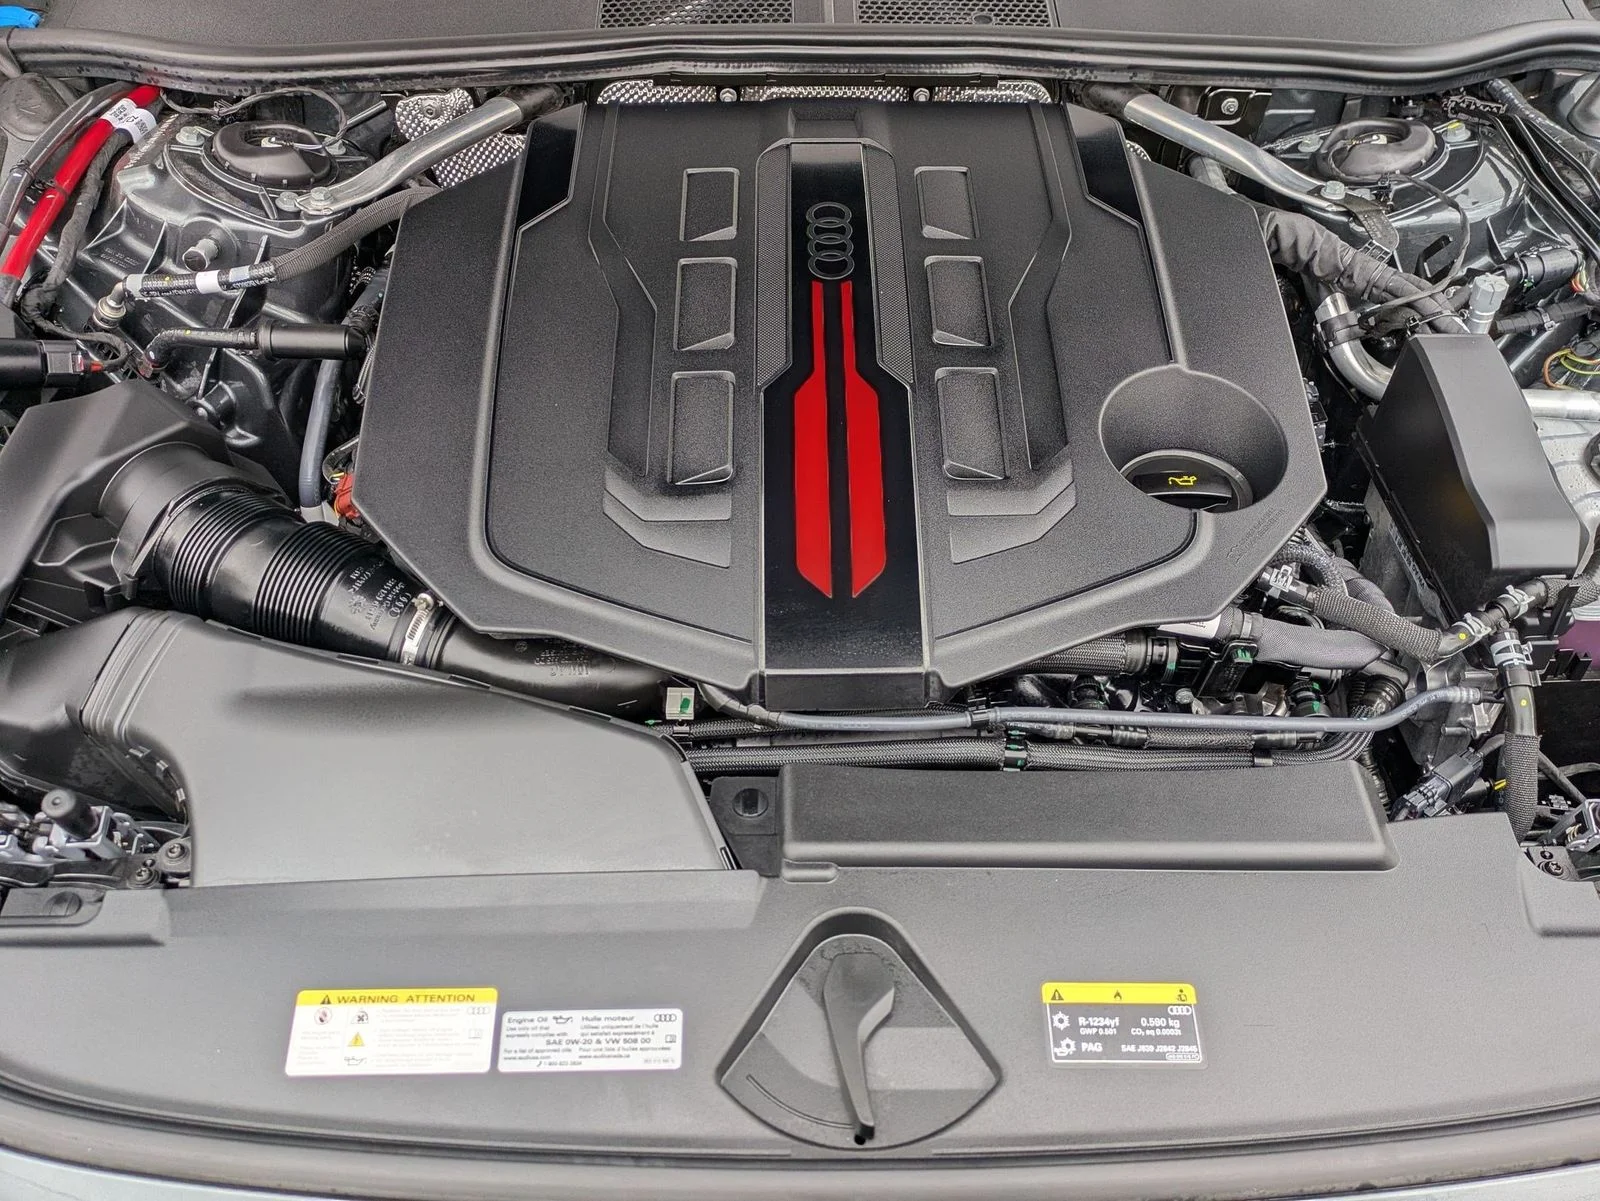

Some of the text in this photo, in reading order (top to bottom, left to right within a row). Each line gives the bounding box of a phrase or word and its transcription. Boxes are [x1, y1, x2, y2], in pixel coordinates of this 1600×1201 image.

[337, 994, 476, 1004] WARNING ATTENTION
[507, 1016, 534, 1024] Engine
[1078, 1017, 1120, 1028] R-1234yf
[1168, 1018, 1180, 1028] kg
[1082, 1042, 1103, 1052] PAG
